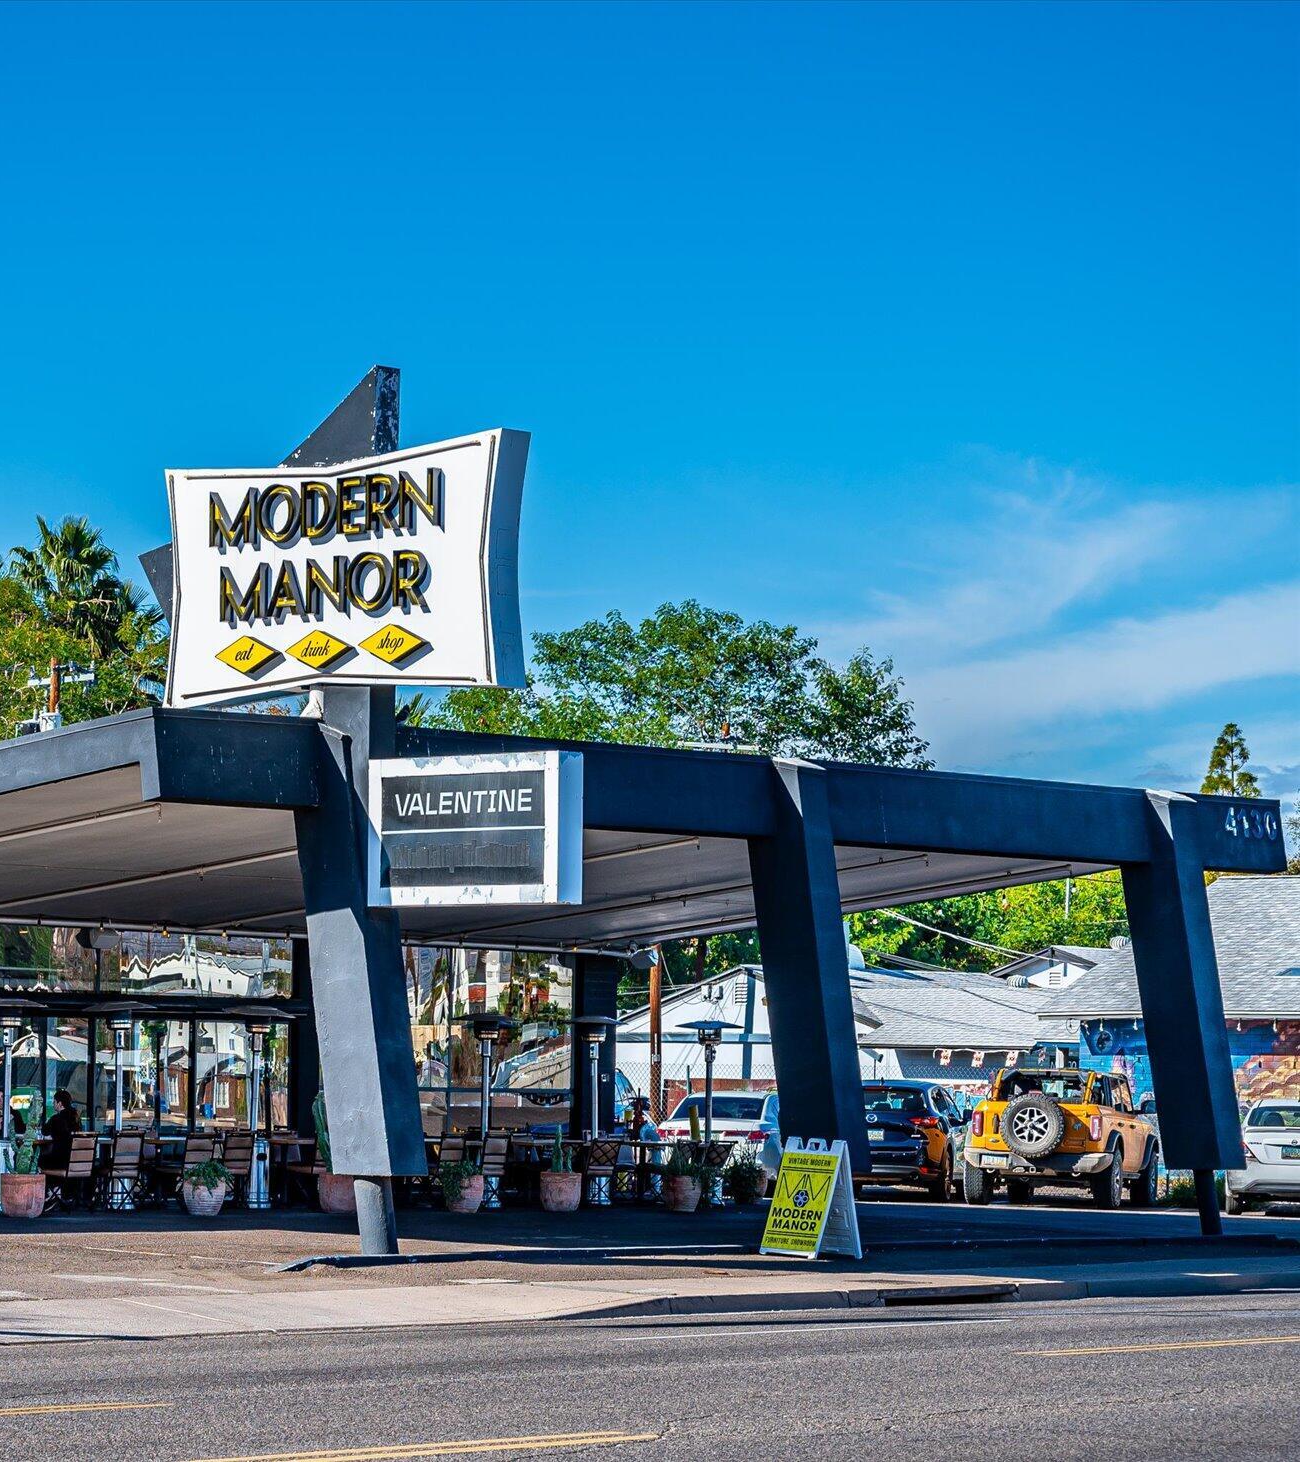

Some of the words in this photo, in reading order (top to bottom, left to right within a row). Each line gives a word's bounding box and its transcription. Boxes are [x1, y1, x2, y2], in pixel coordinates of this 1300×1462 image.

[209, 467, 445, 553] MODERN
[220, 549, 432, 626] MANOR
[234, 643, 255, 661] eat
[300, 638, 330, 657] drink
[376, 631, 404, 655] shop
[395, 788, 533, 817] VALENTINE
[1225, 806, 1278, 841] 4130
[788, 1157, 809, 1166] VINTAGE
[810, 1158, 831, 1167] MODERN
[771, 1207, 822, 1221] MODERN
[771, 1219, 817, 1232] MANOR
